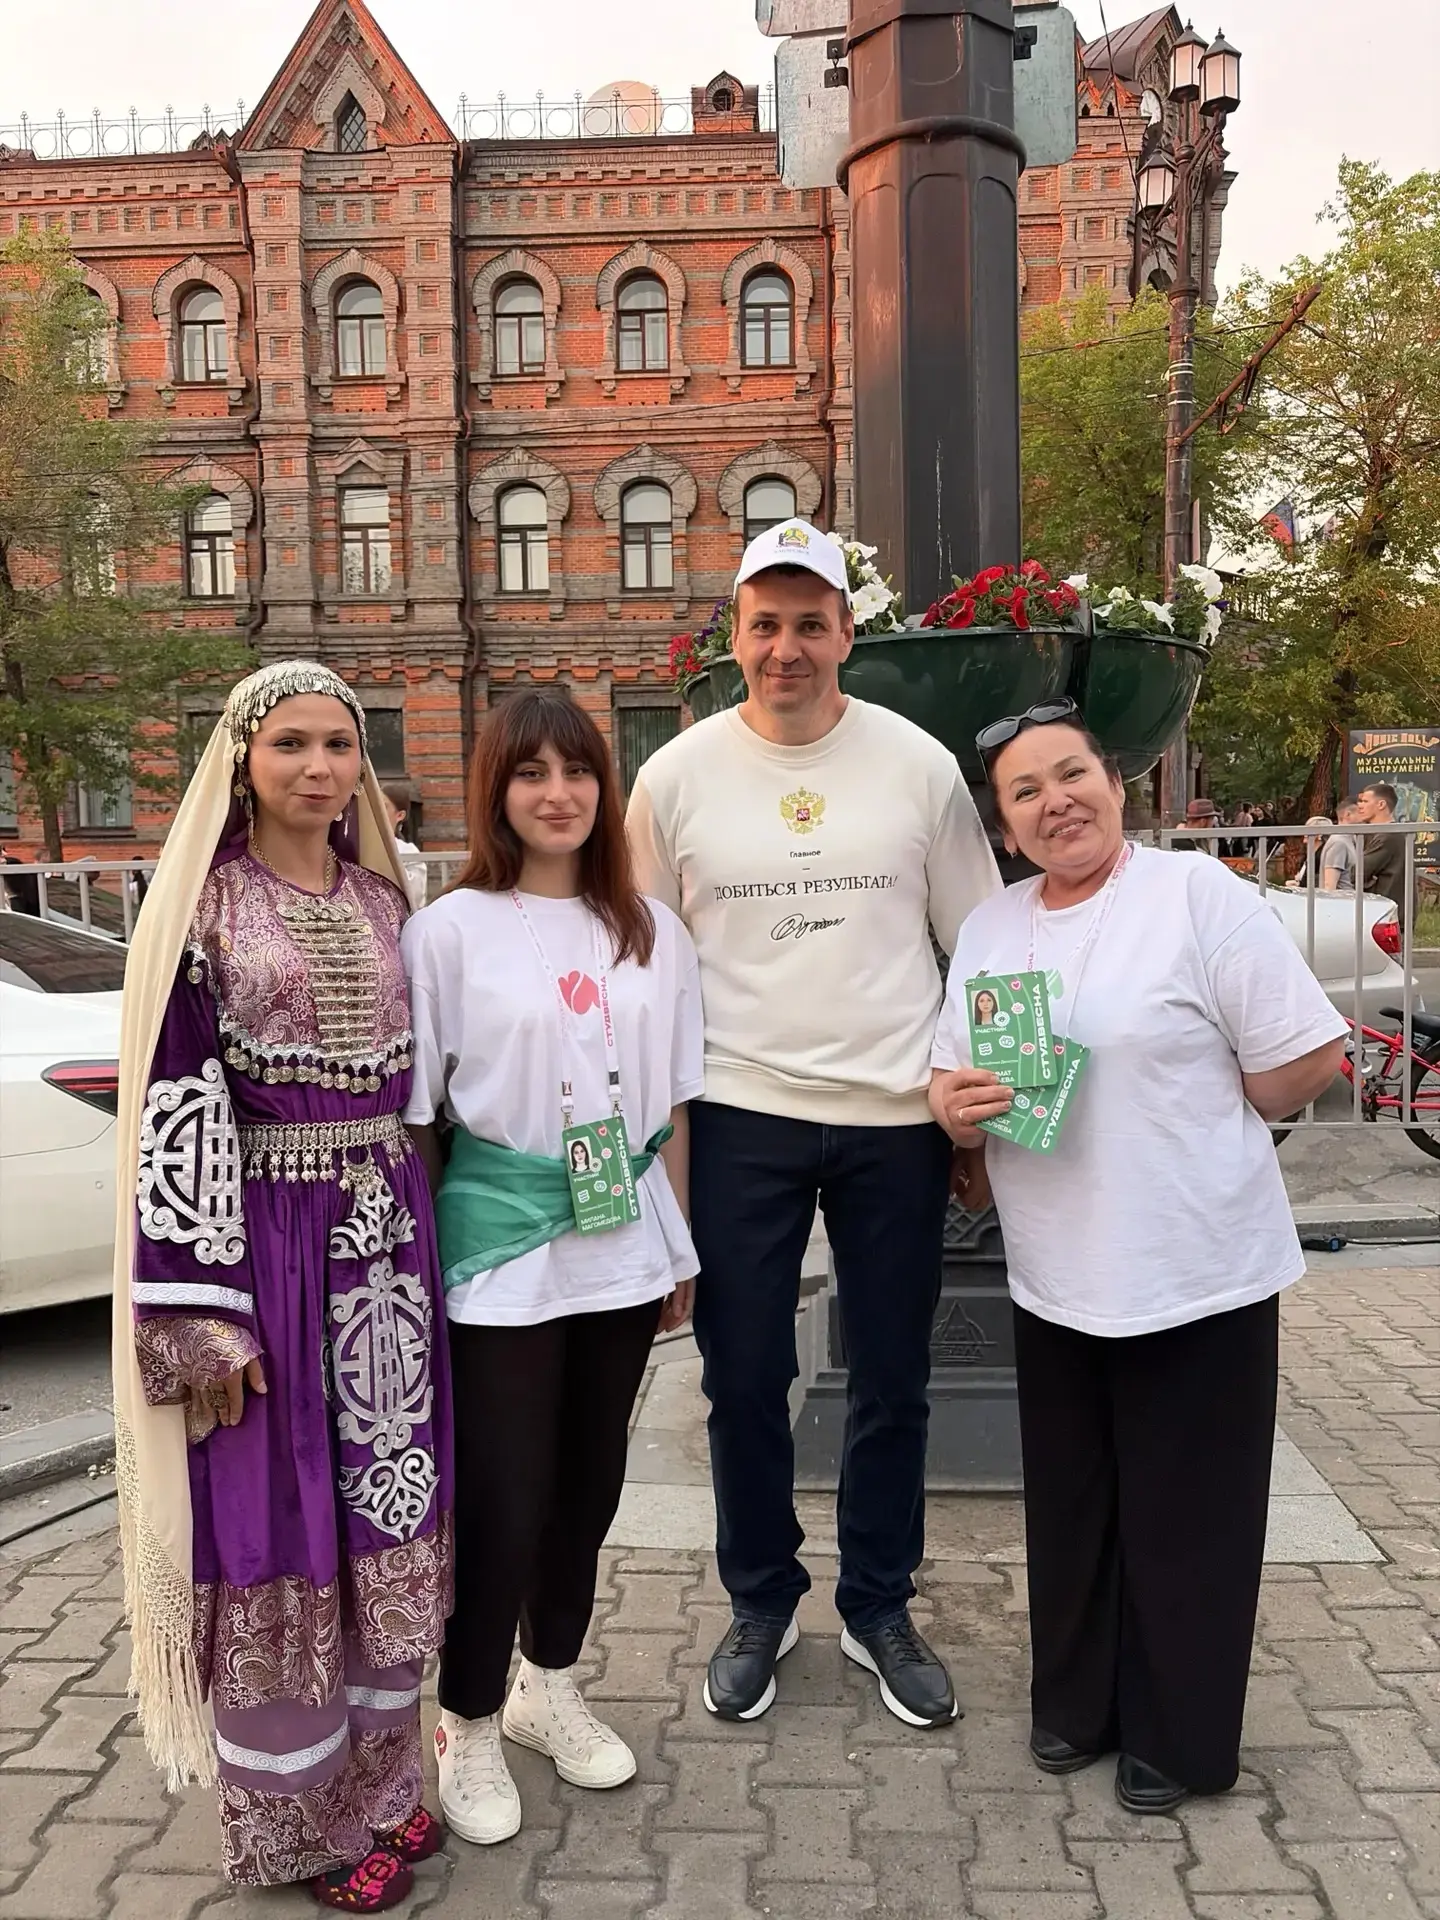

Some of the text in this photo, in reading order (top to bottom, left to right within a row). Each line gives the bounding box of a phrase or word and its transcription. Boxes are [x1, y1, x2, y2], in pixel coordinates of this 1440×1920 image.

[1356, 756, 1436, 766] МУЗЫКАЛЬНЫЕ
[1358, 765, 1434, 774] ИНСТРУМЕНТЫ
[789, 850, 821, 858] Главное
[714, 875, 899, 901] ДОБИТЬСЯ РЕЗУЛЬТАТА!
[600, 976, 614, 1047] СТУДВЕСНА
[1032, 983, 1051, 1080] СТУДВЕСНА
[1041, 1058, 1081, 1149] СТУДВЕСНА
[616, 1128, 638, 1217] СТУДВЕСНА
